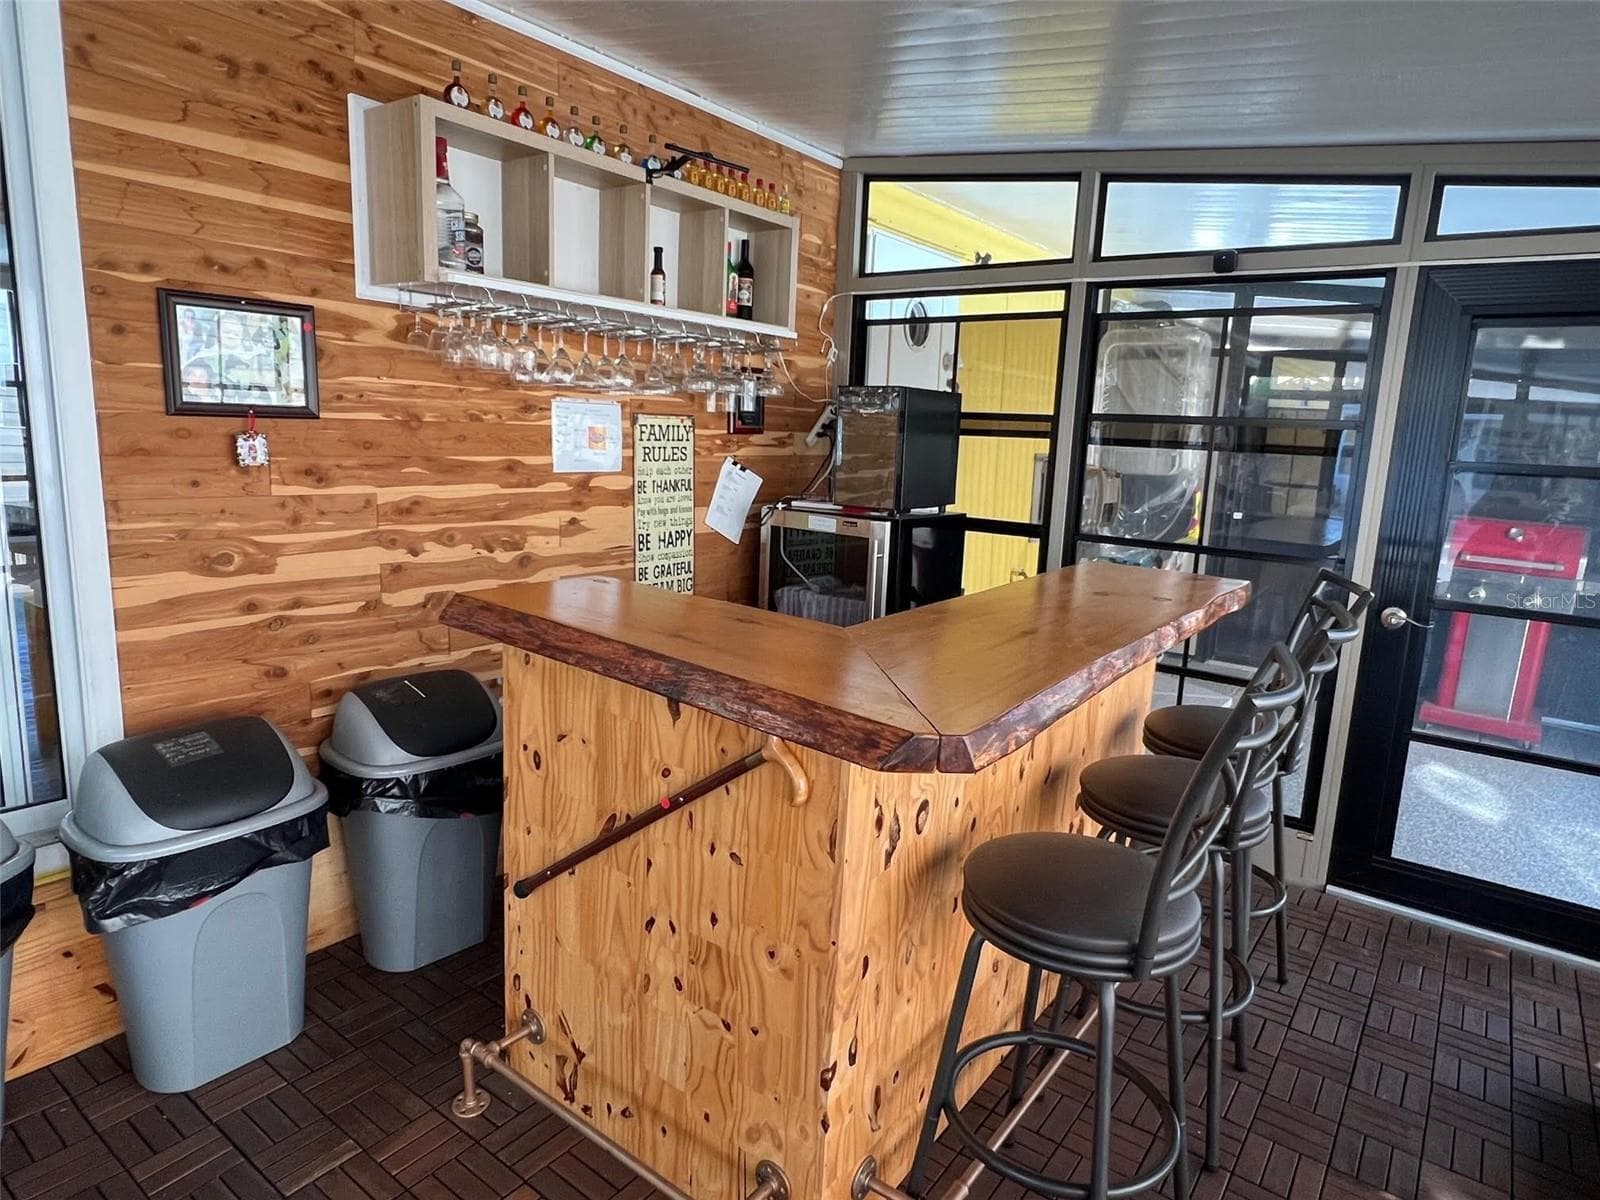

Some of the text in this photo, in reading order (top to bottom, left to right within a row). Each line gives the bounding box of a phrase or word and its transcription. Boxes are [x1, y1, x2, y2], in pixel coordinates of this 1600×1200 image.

[638, 424, 692, 441] FAMILY
[642, 446, 687, 462] RULES
[637, 479, 692, 494] BE THANKFUL
[638, 529, 692, 552] BE HAPPY
[638, 561, 692, 581] BE GRATEFUL
[677, 578, 692, 592] BIG
